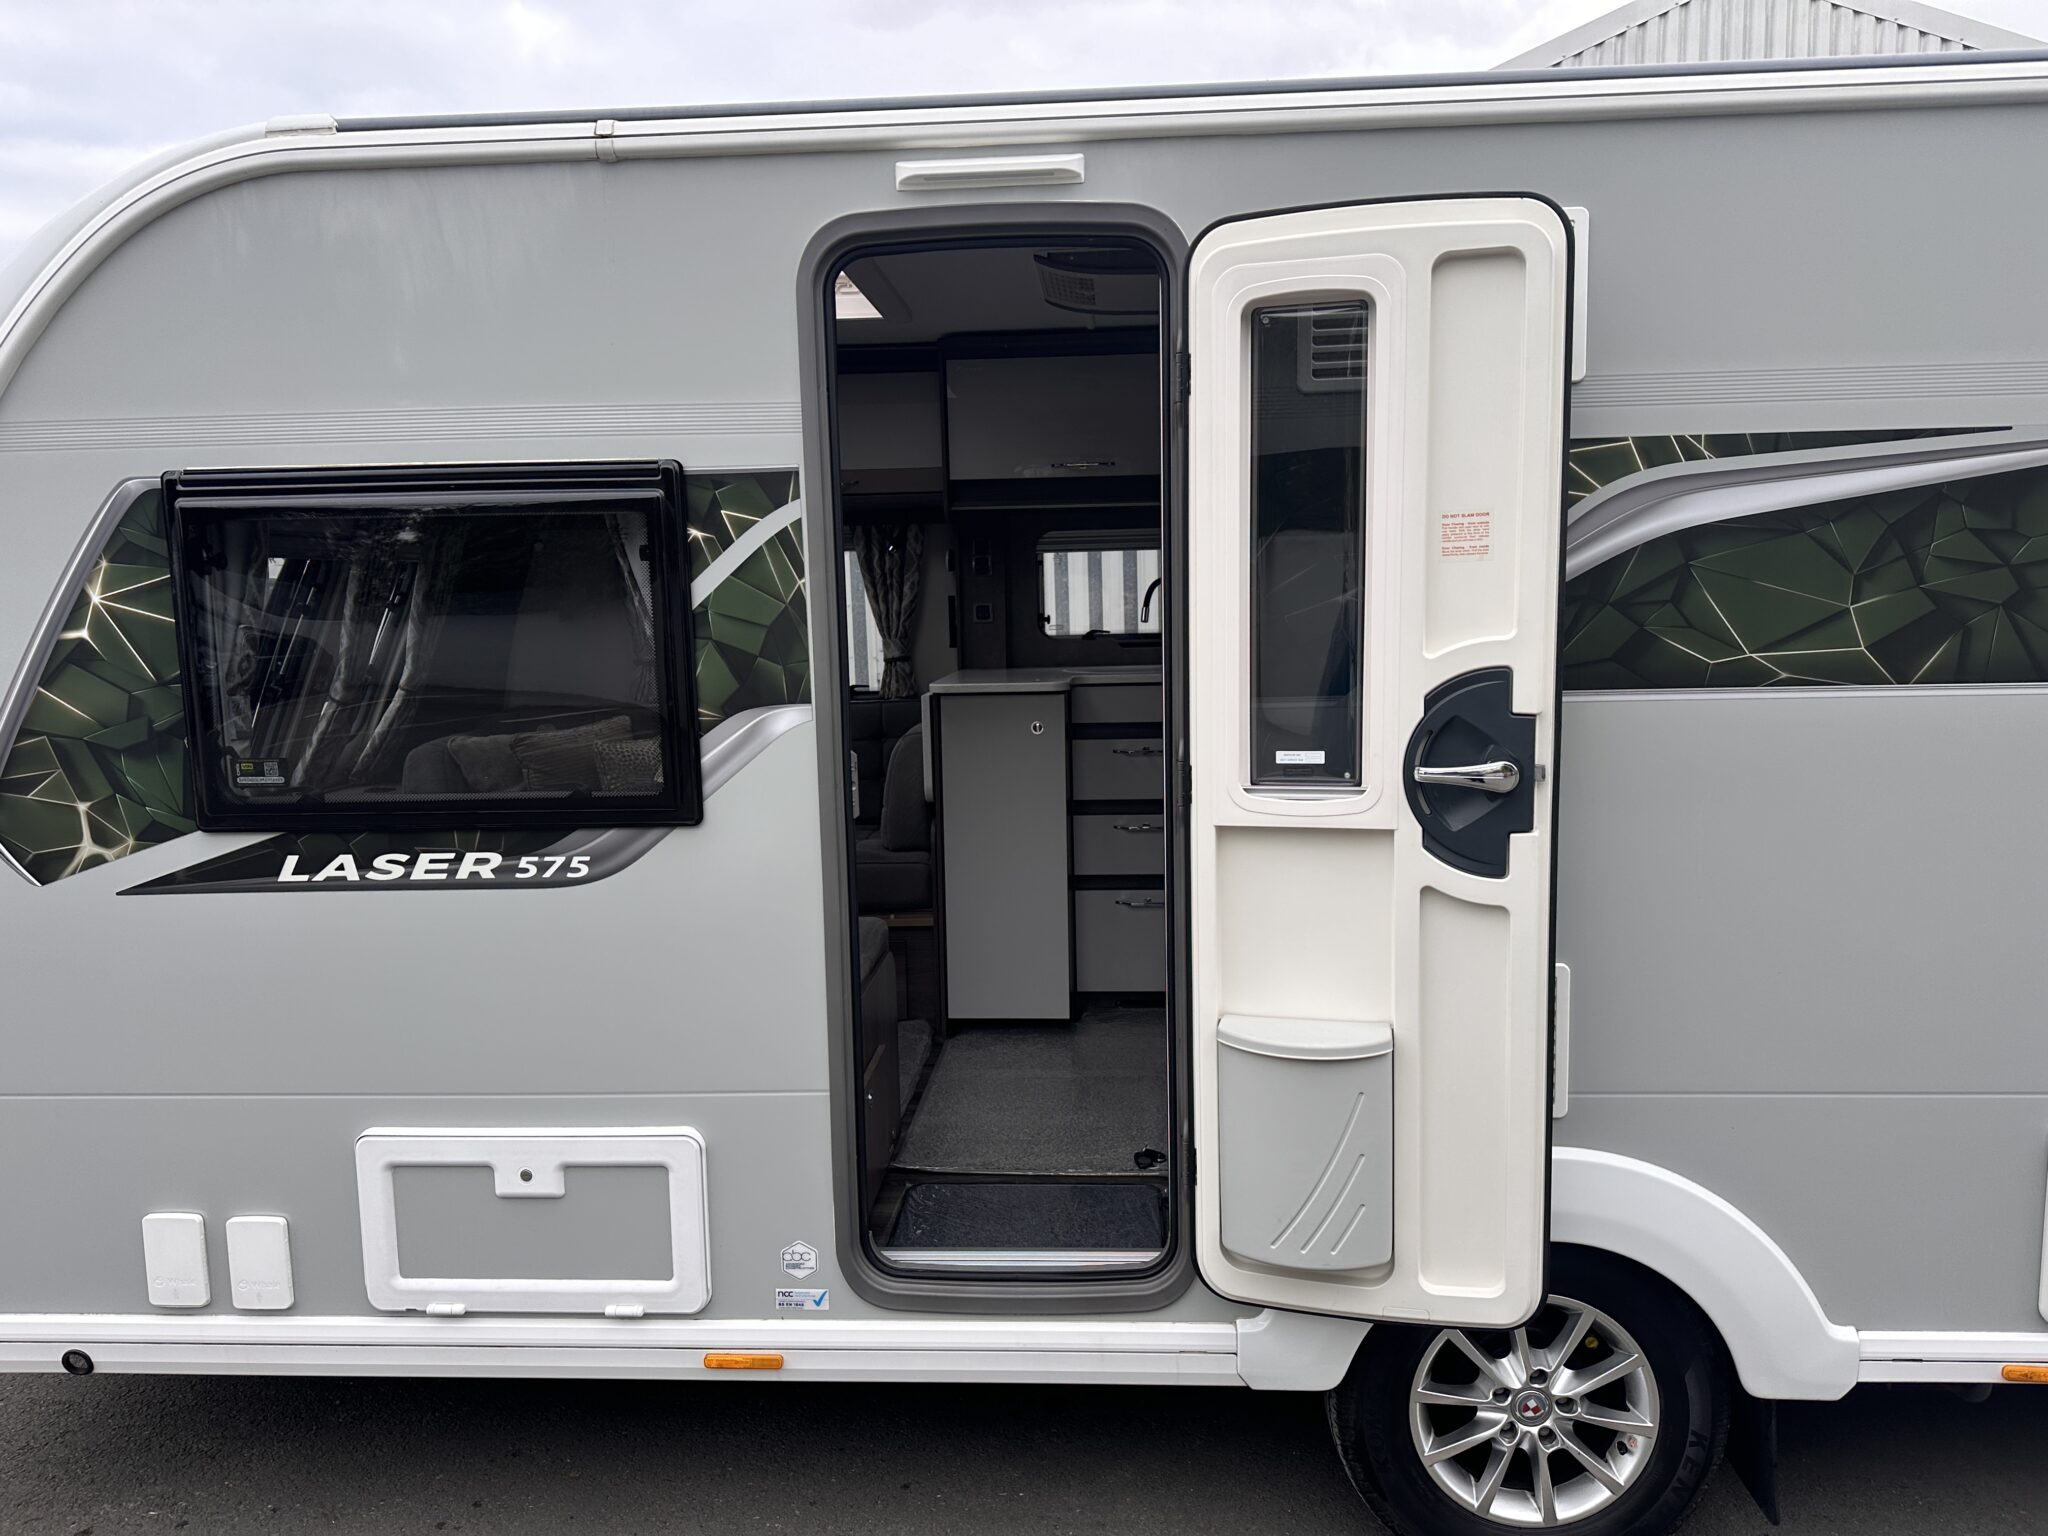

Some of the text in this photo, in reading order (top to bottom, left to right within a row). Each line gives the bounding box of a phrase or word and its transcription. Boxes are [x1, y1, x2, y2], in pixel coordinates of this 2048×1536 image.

[277, 851, 591, 882] LASER 575
[783, 1249, 811, 1261] abc
